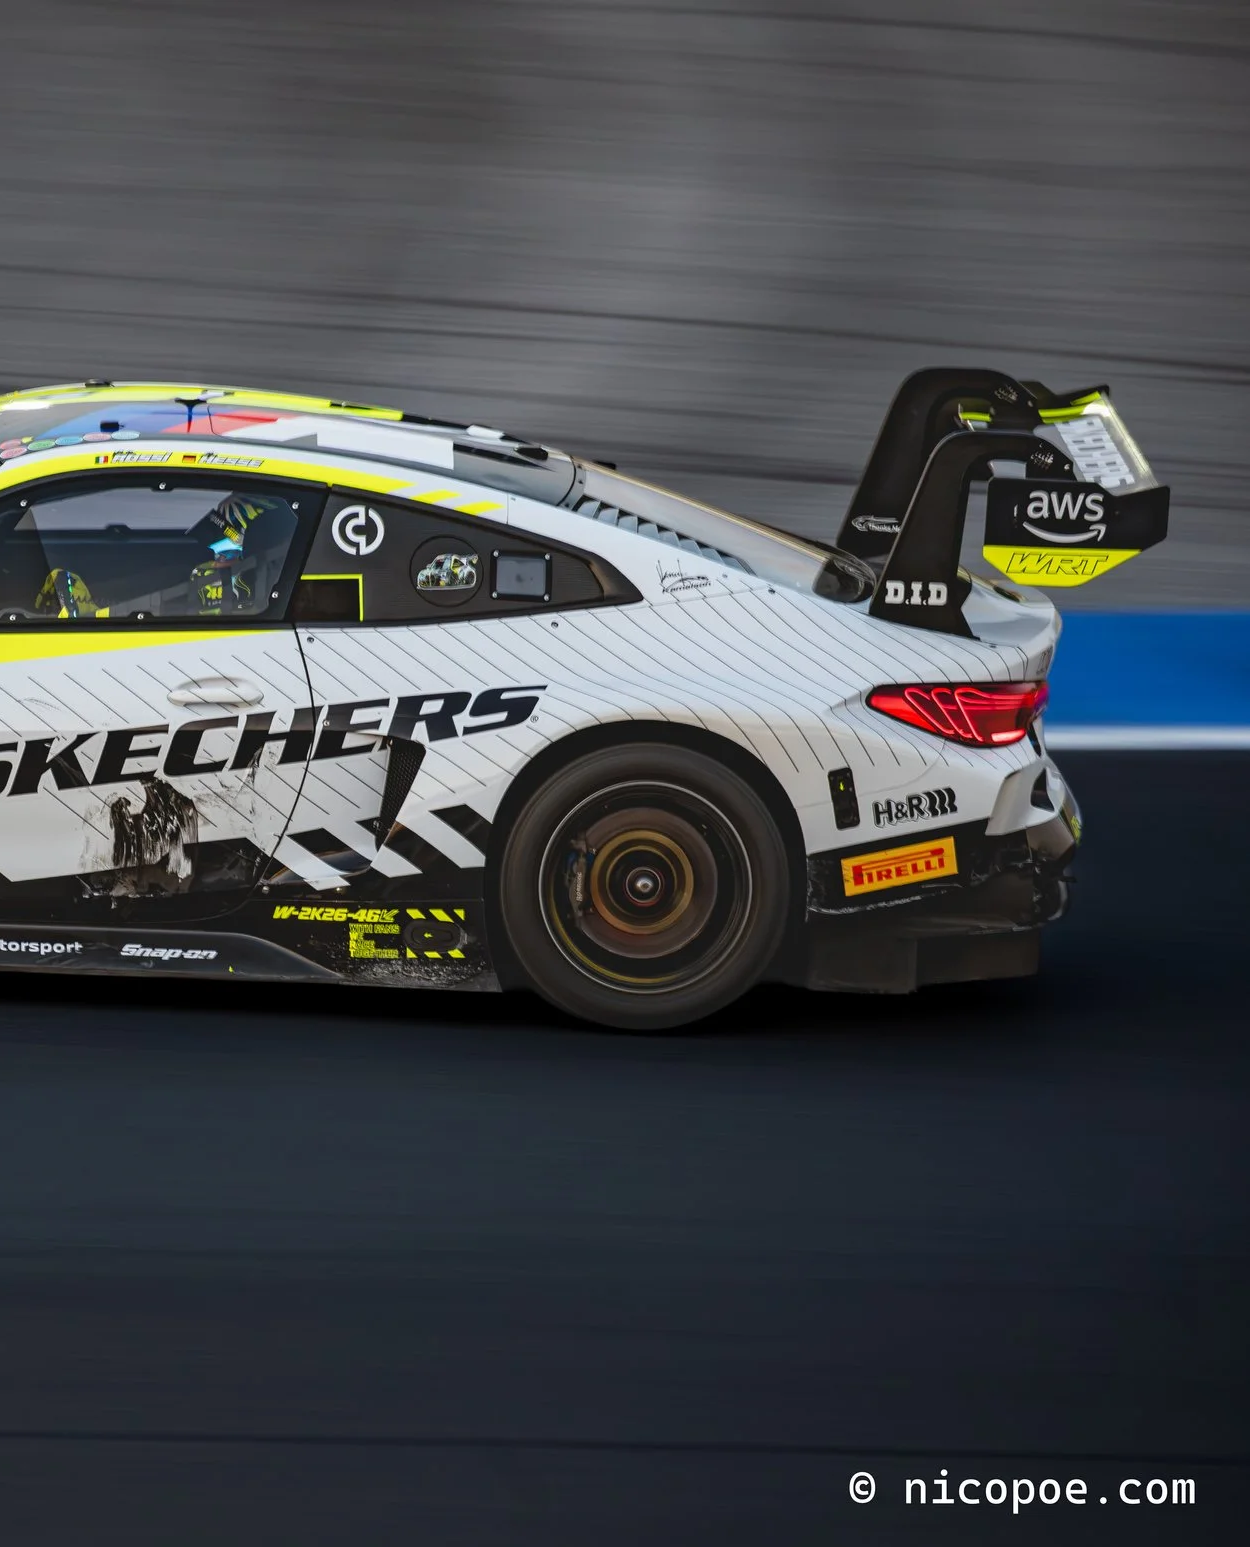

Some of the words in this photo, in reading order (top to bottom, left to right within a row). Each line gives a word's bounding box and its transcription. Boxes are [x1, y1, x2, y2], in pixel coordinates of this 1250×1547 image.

[1027, 490, 1105, 521] aws
[1006, 552, 1110, 576] WRT
[885, 580, 947, 606] D.I.D
[852, 847, 945, 886] PIRELLI
[273, 905, 381, 922] W-2K26-46
[120, 943, 218, 960] Snap-on
